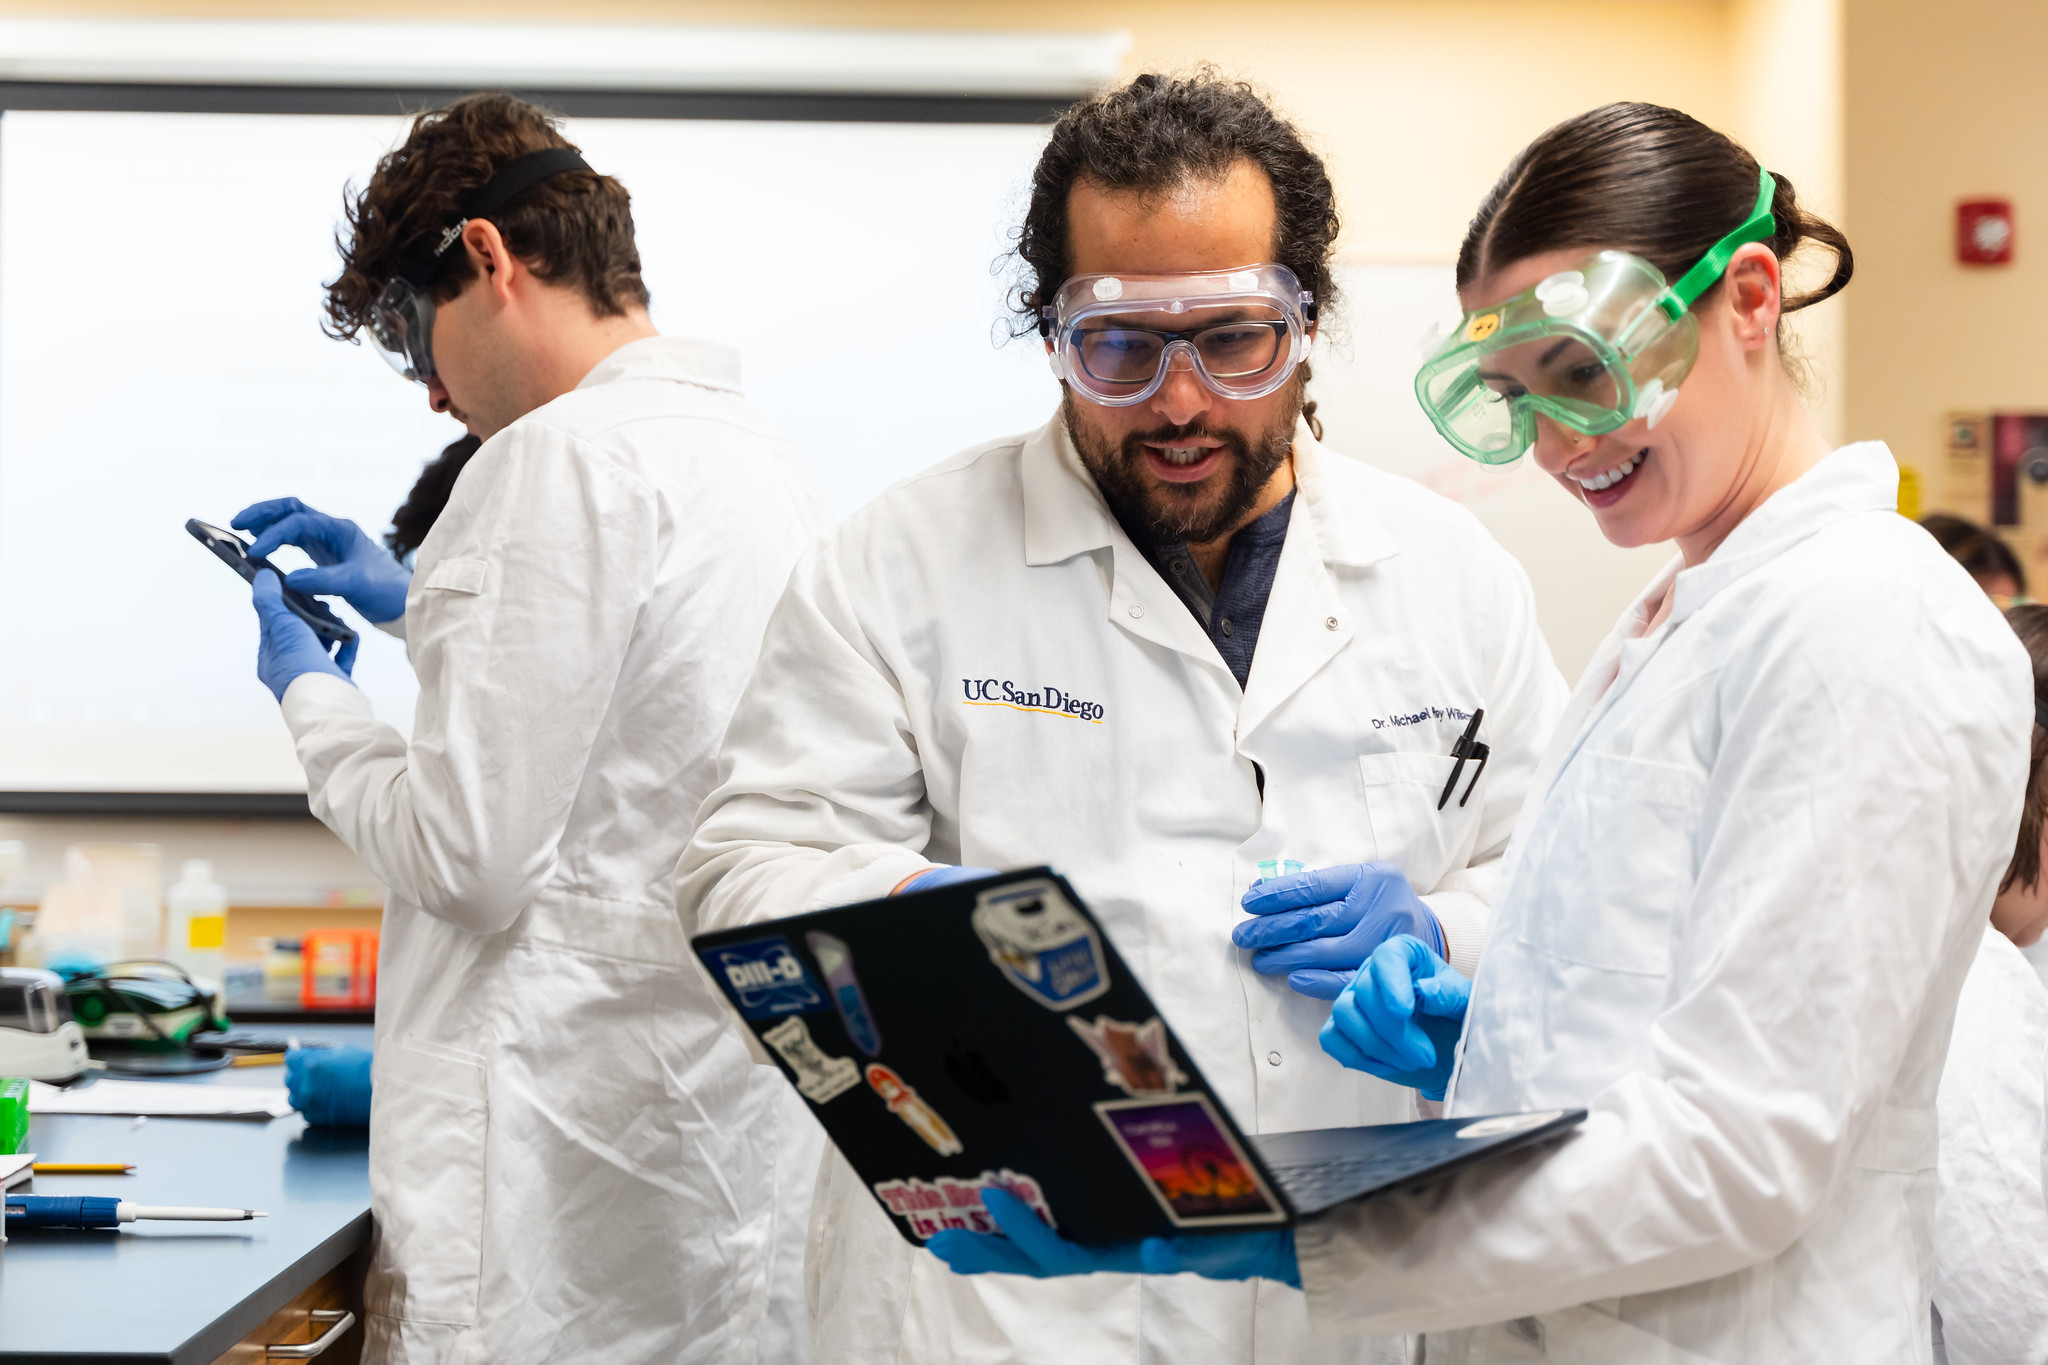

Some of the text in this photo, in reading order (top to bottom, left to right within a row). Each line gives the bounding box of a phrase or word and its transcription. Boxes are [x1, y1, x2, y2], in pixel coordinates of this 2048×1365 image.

[962, 678, 1104, 721] UC San Diego
[1371, 718, 1390, 729] Dr.
[1389, 707, 1431, 727] Michael
[881, 1183, 947, 1213] This
[911, 1212, 939, 1236] is
